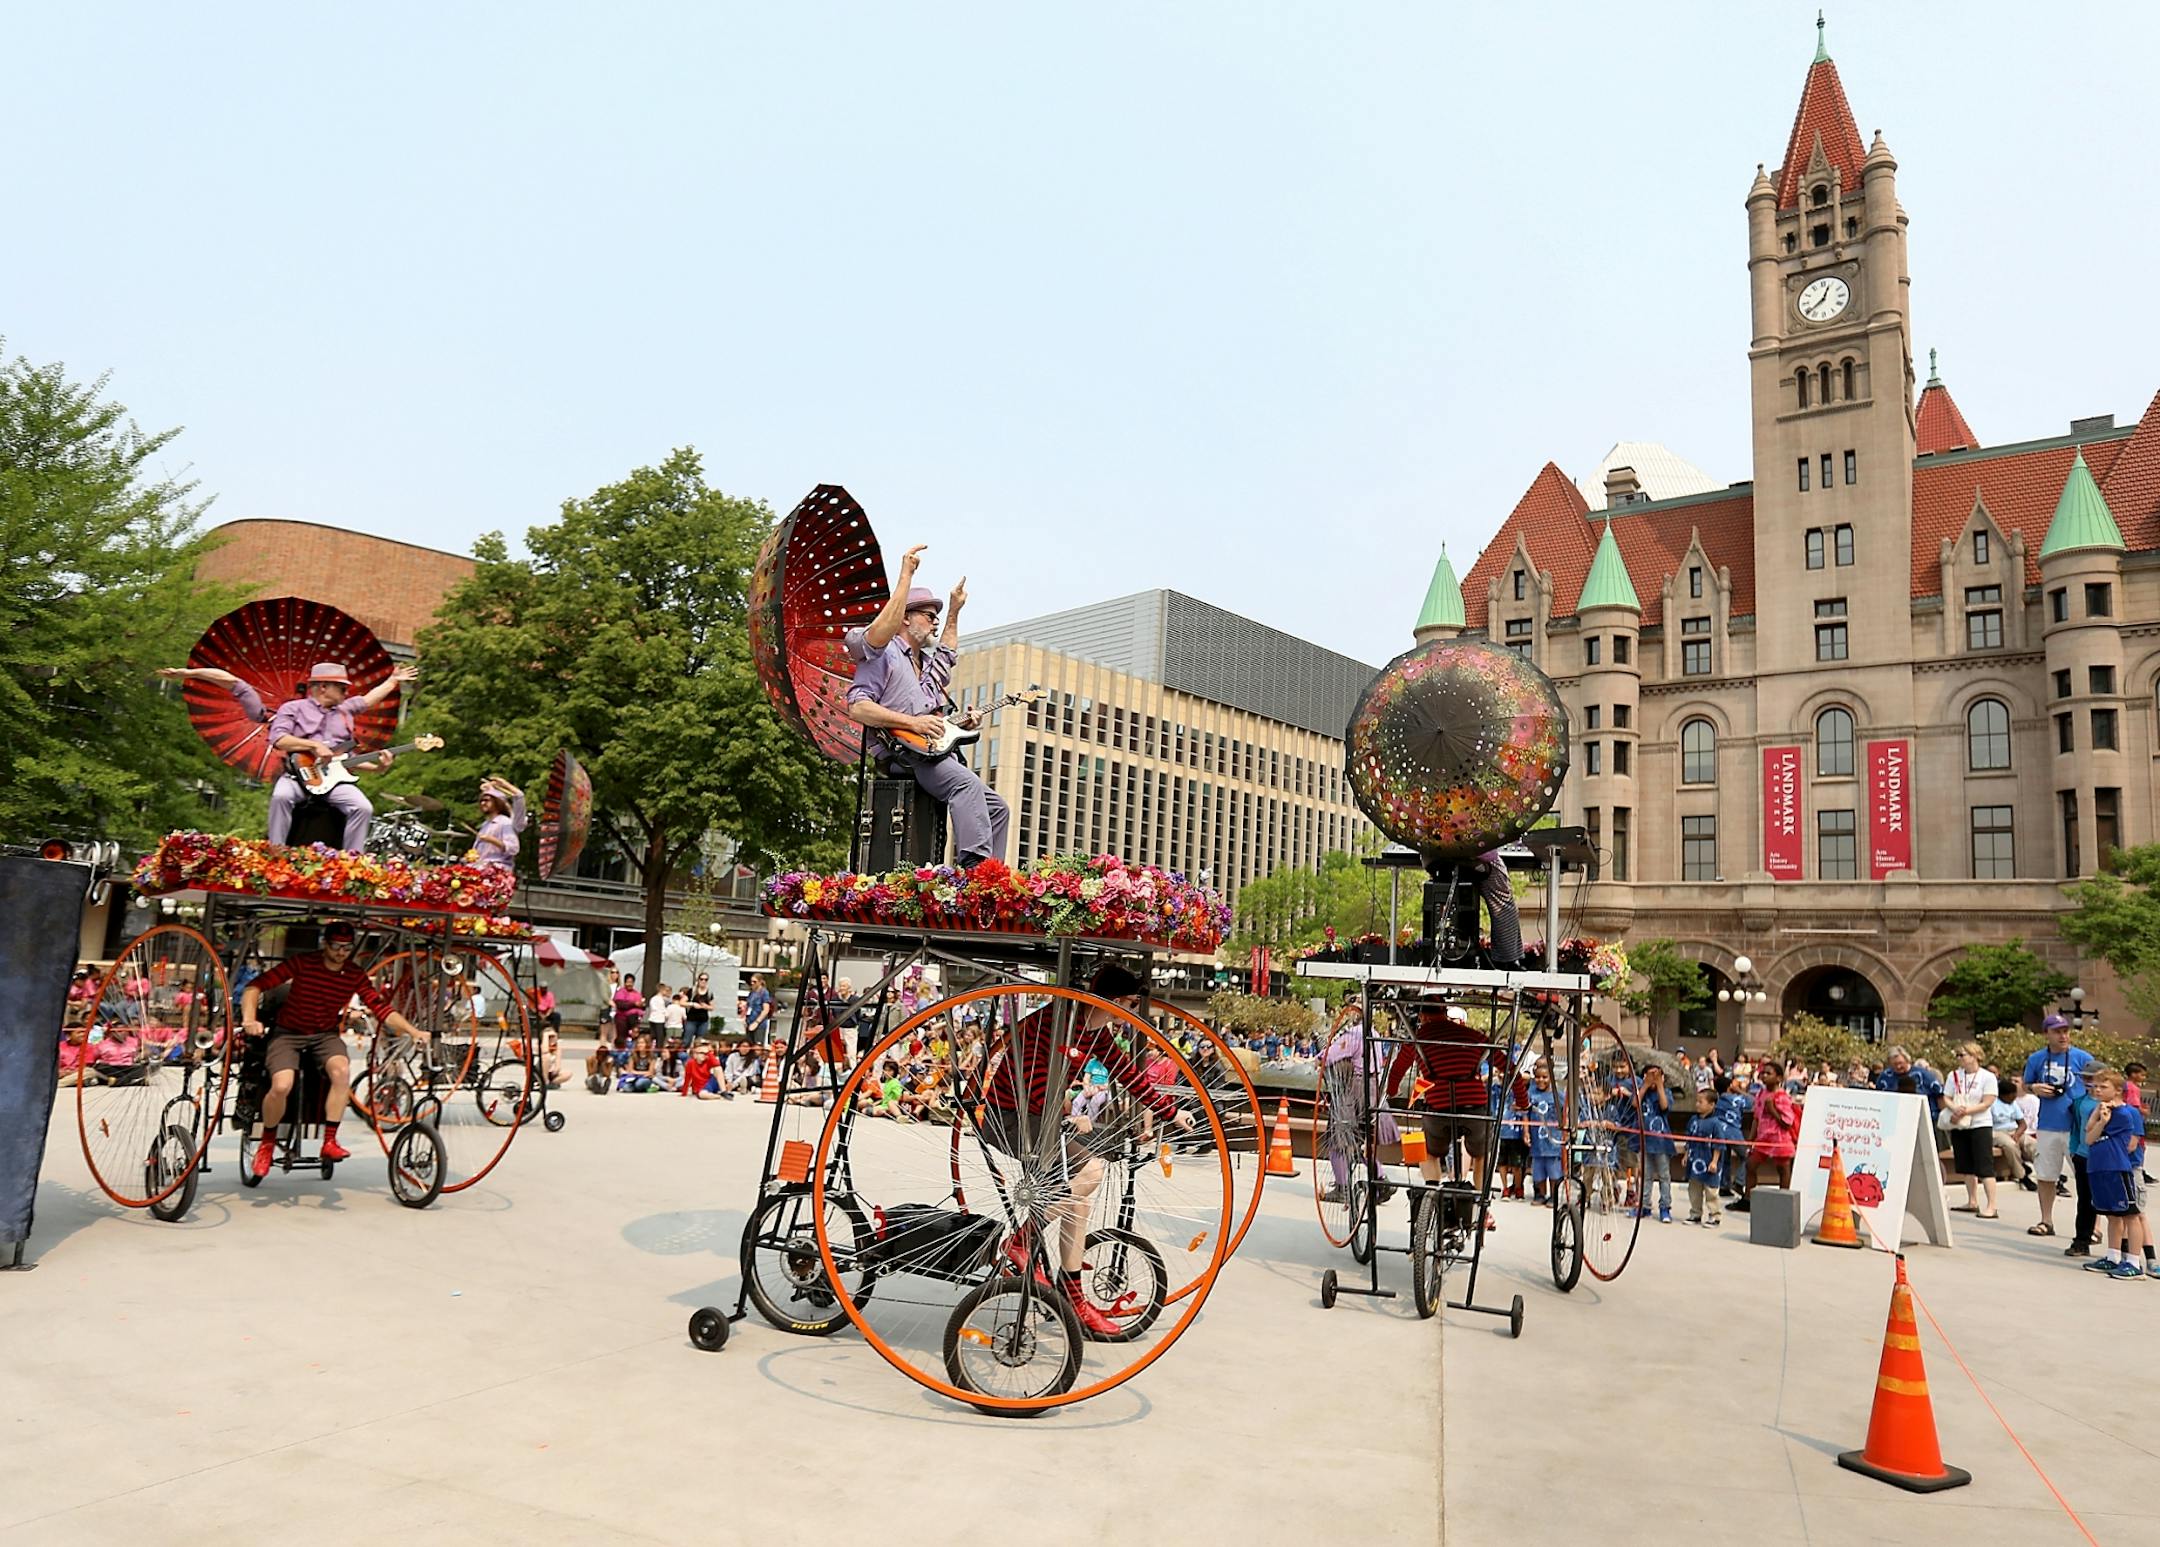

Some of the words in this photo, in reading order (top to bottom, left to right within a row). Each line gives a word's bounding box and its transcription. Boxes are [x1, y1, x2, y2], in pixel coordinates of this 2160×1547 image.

[1782, 753, 1796, 836] LANDMARK
[1878, 758, 1886, 824] CENTER
[1888, 748, 1903, 832] LANDMARK
[1825, 1112, 1880, 1130] Squonk
